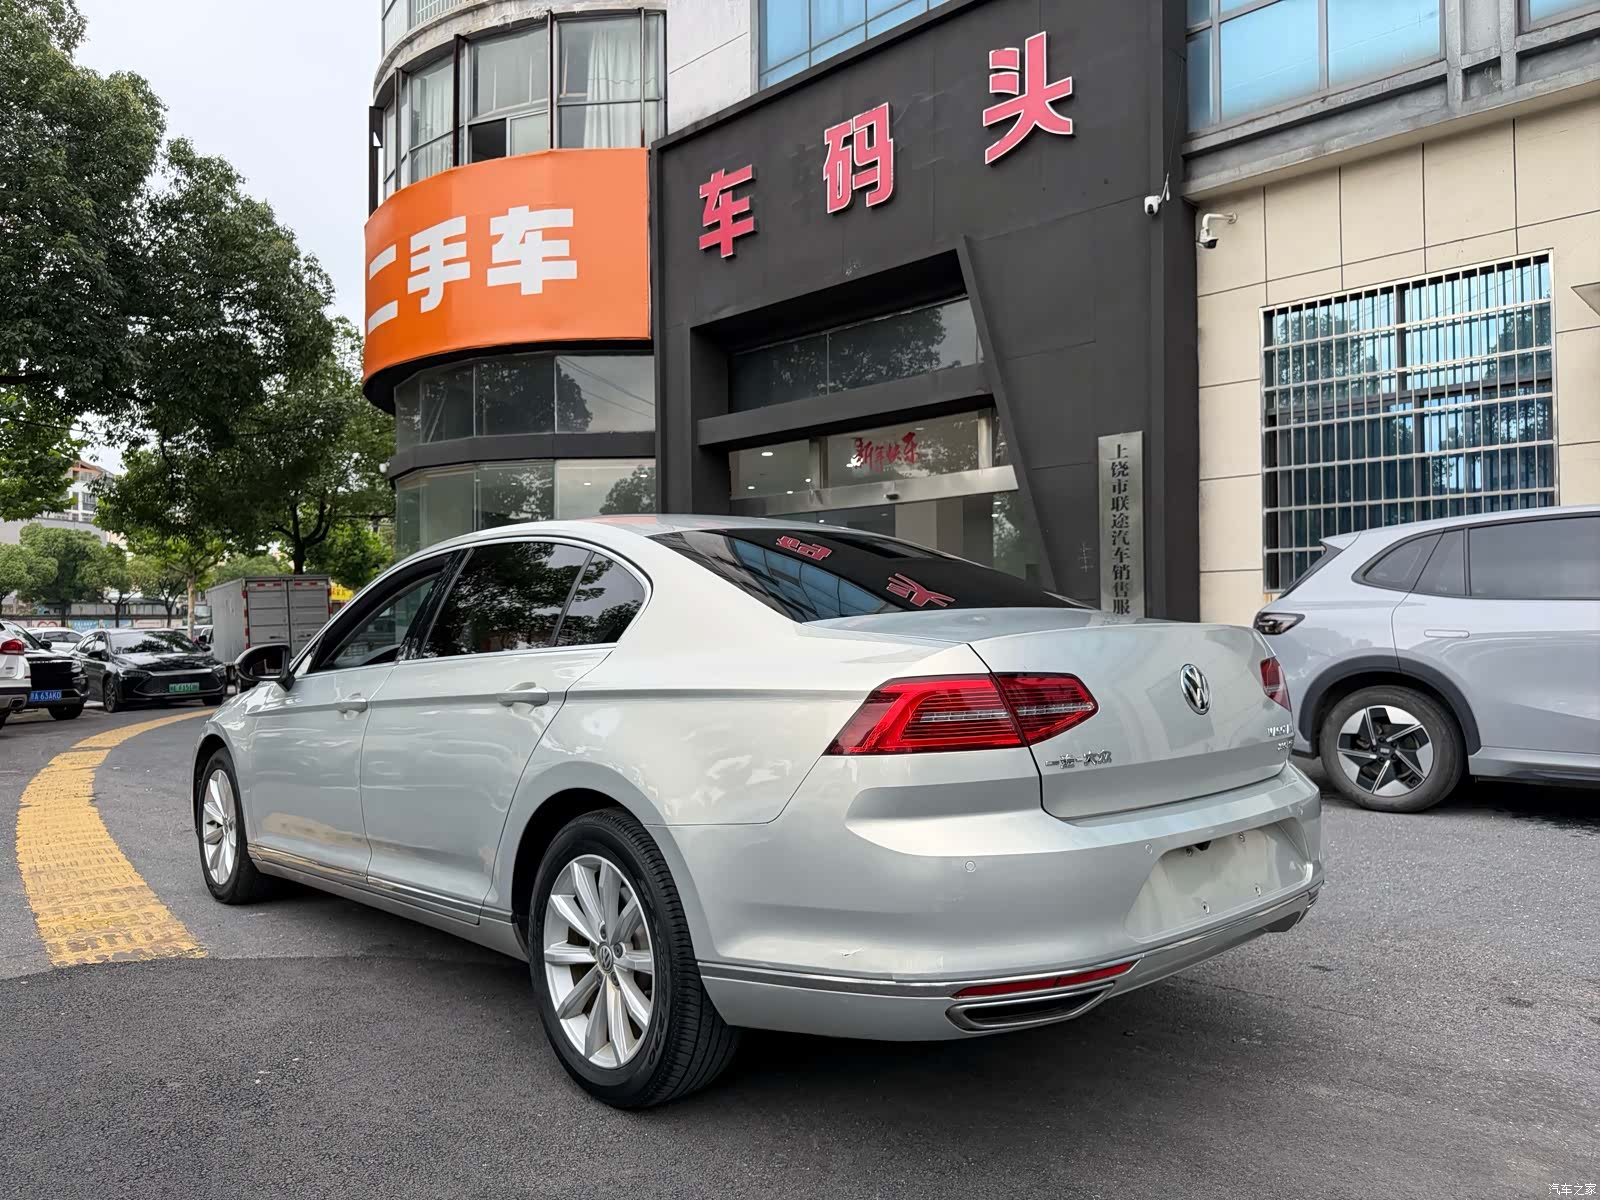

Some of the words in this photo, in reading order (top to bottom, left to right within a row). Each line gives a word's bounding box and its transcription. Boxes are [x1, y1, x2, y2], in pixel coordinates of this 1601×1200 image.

[698, 31, 1073, 259] 车码头
[367, 204, 578, 336] 二手车
[1109, 443, 1131, 615] 上饶市联途汽车销售服
